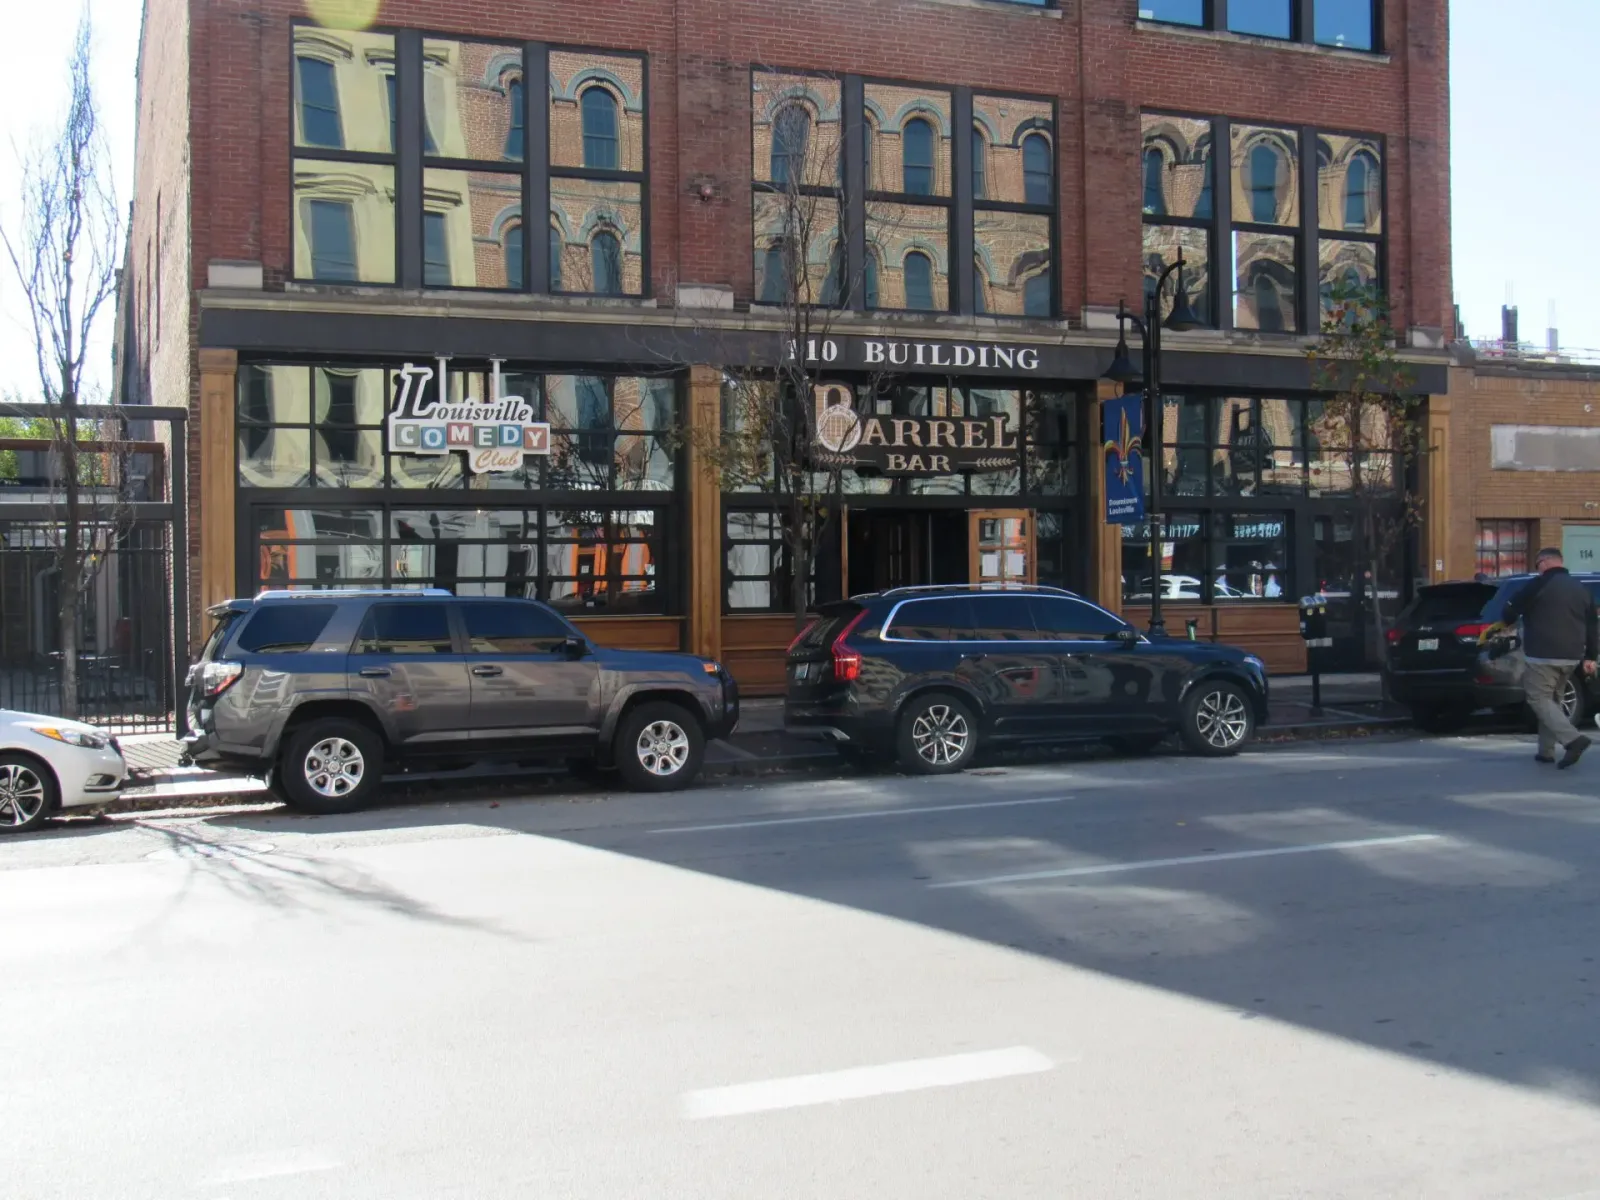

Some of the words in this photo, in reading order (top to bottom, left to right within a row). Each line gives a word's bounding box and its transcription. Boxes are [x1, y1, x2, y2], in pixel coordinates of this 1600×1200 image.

[786, 339, 838, 361] 110
[864, 341, 1040, 370] BUILDING
[395, 371, 529, 422] Louisville
[398, 424, 545, 448] COMEDY
[475, 450, 518, 468] Club
[886, 454, 951, 471] BAR
